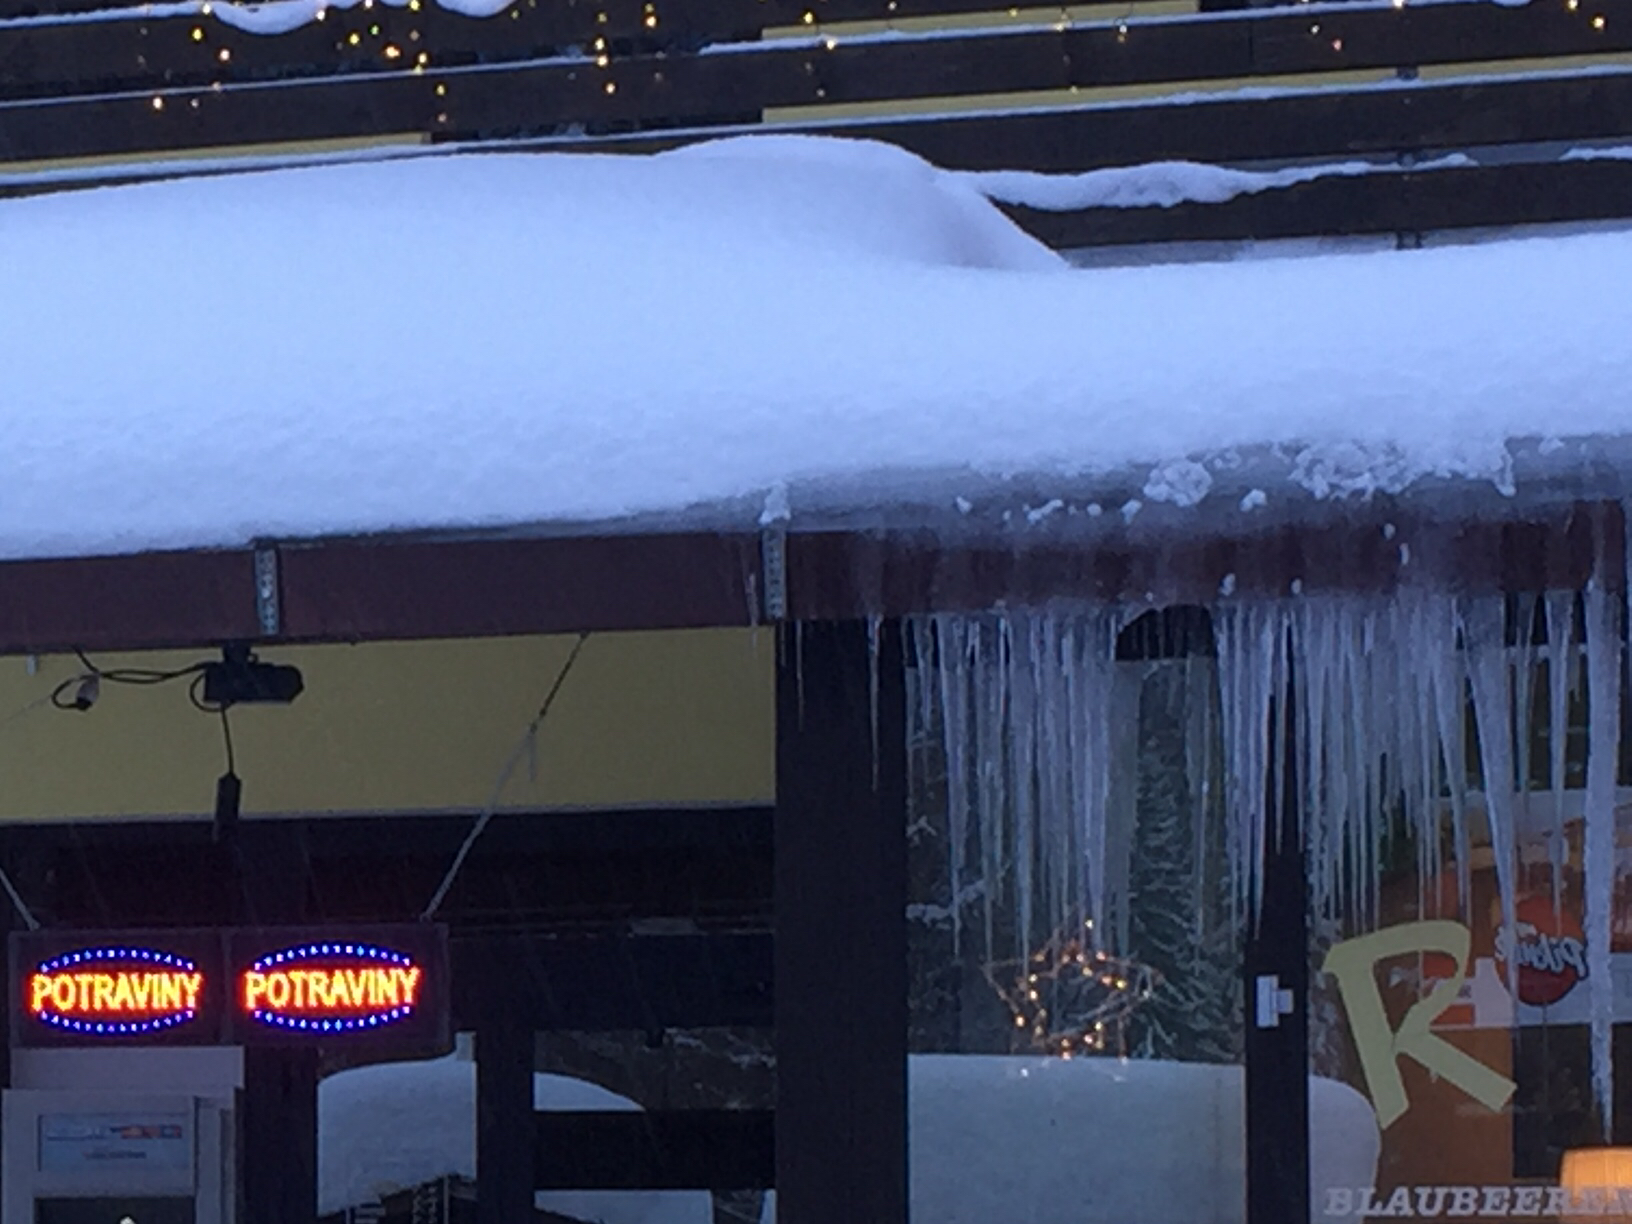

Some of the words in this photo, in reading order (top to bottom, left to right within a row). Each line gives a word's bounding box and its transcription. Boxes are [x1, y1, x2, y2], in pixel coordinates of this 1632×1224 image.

[31, 971, 203, 1012] POTRAVINY
[244, 966, 421, 1009] POTRAVINY
[1323, 919, 1518, 1130] R
